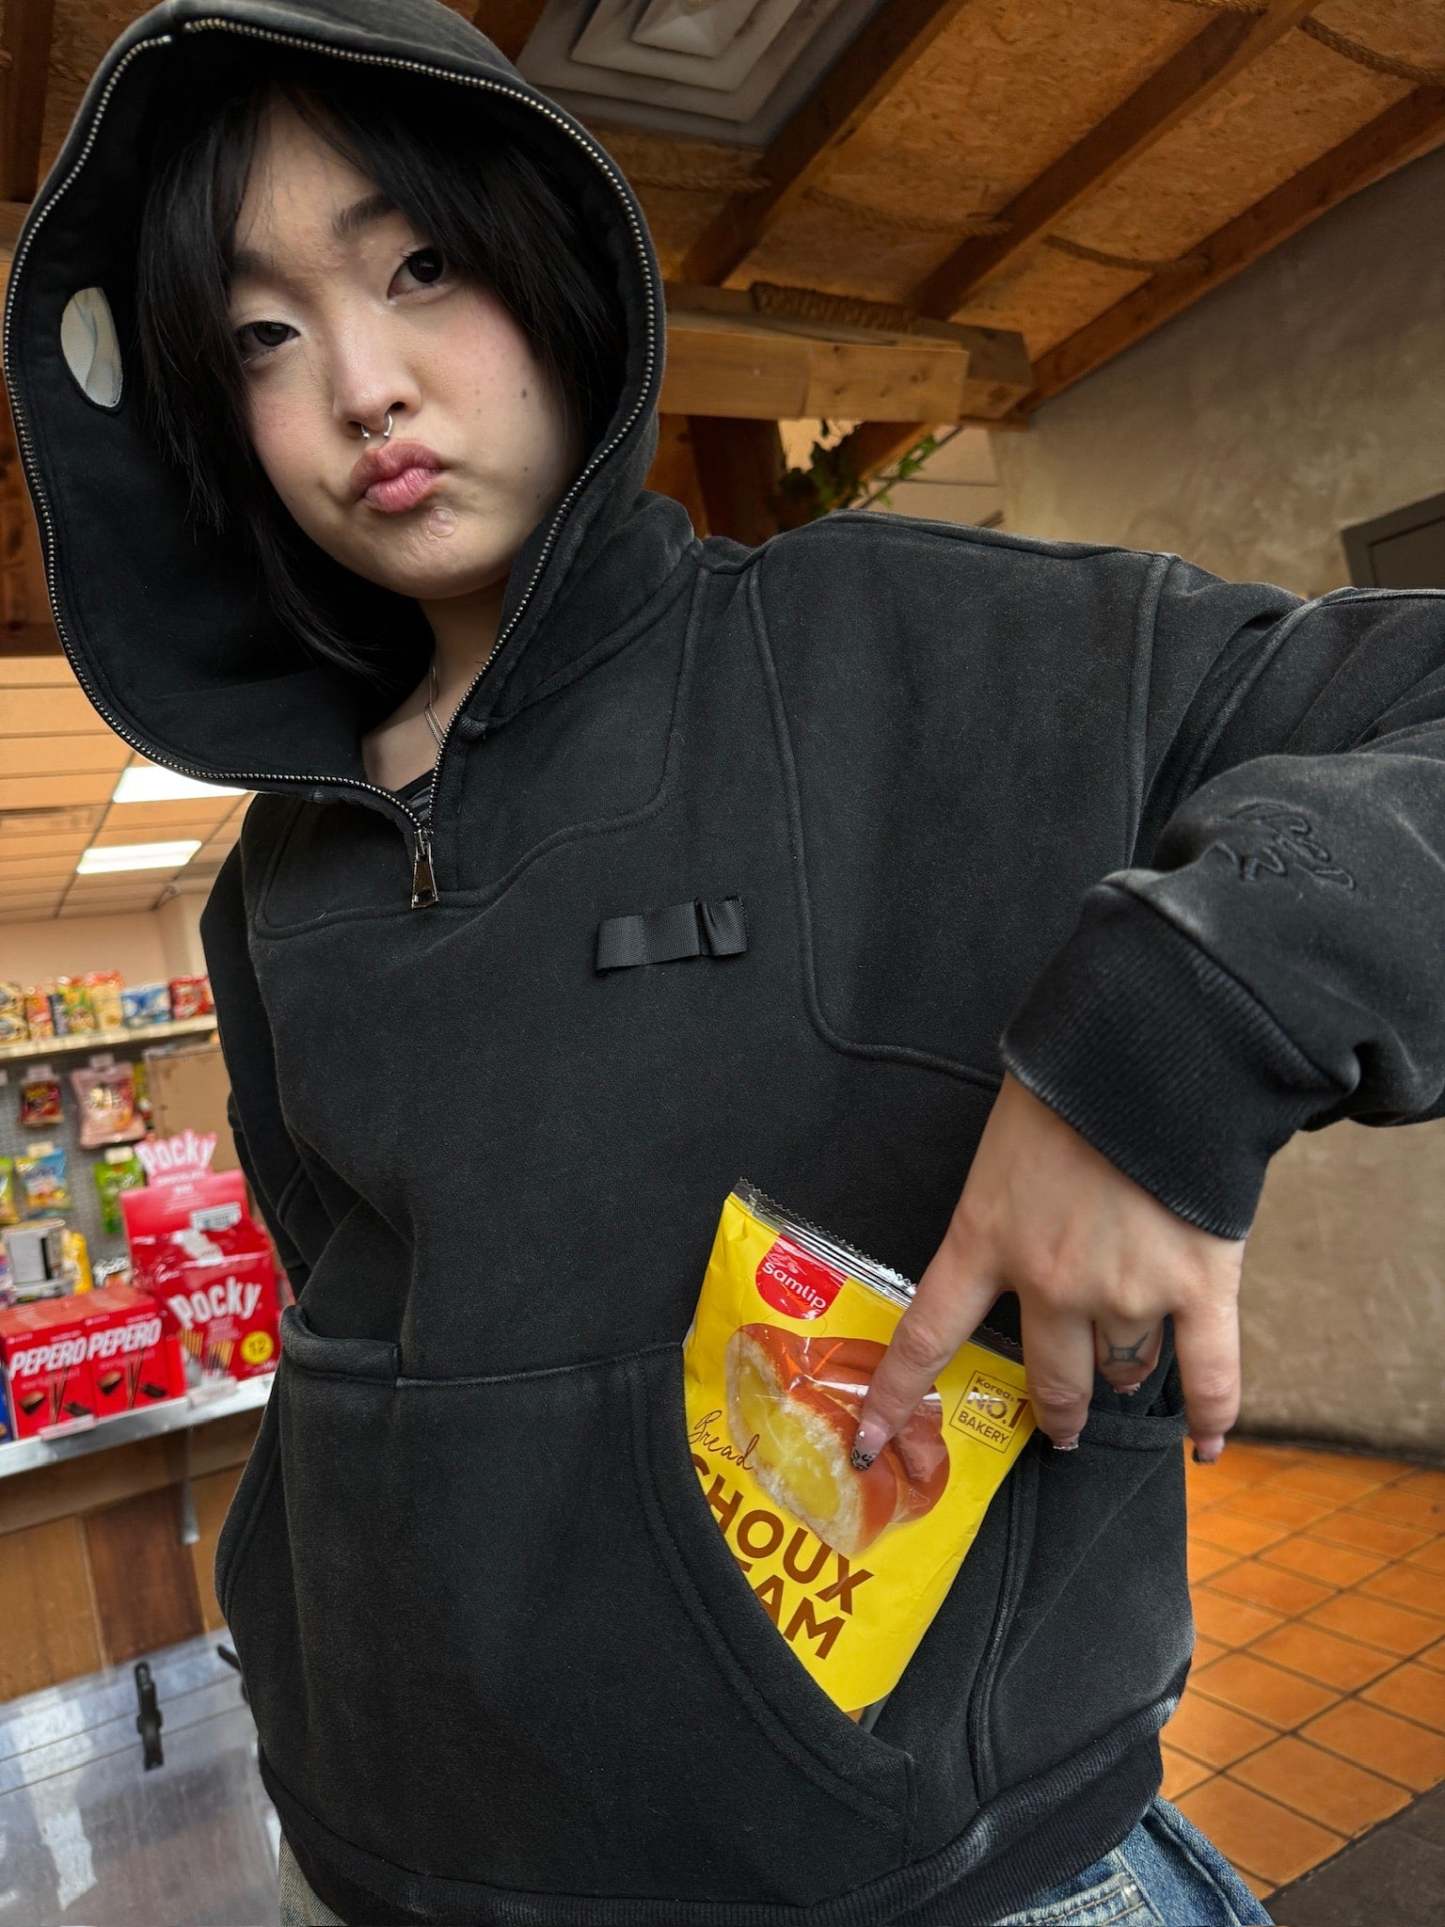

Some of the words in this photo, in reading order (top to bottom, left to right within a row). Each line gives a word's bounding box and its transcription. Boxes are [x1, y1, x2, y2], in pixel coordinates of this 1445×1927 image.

[135, 1130, 216, 1175] Pocky
[169, 1277, 261, 1329] Pocky
[762, 1262, 827, 1310] samlip
[10, 1337, 87, 1380] PEPERO
[87, 1319, 161, 1360] PEPERO
[688, 1410, 760, 1470] Bread
[957, 1410, 1009, 1445] BAKERY
